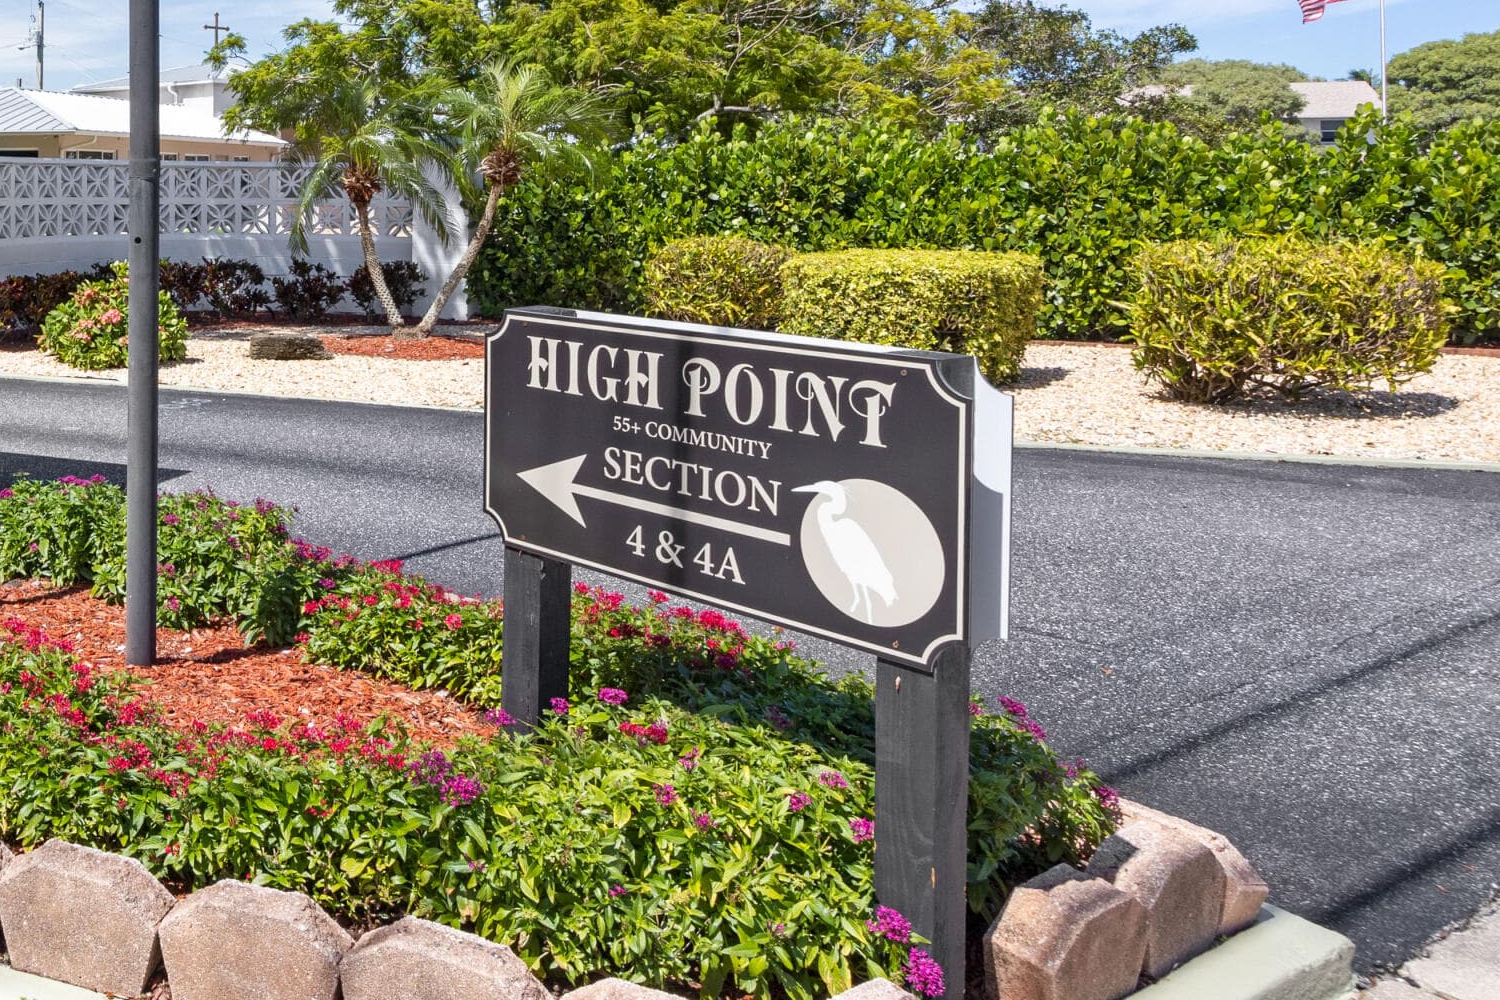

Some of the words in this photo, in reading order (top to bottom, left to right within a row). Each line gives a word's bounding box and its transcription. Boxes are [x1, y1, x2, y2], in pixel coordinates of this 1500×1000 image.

[526, 335, 664, 410] HIGH
[682, 356, 897, 448] POINT
[613, 415, 641, 436] 55+
[645, 421, 772, 460] COMMUNITY
[603, 446, 782, 516] SECTION
[626, 524, 646, 557] 4
[655, 532, 684, 569] &
[693, 542, 746, 585] 4A
